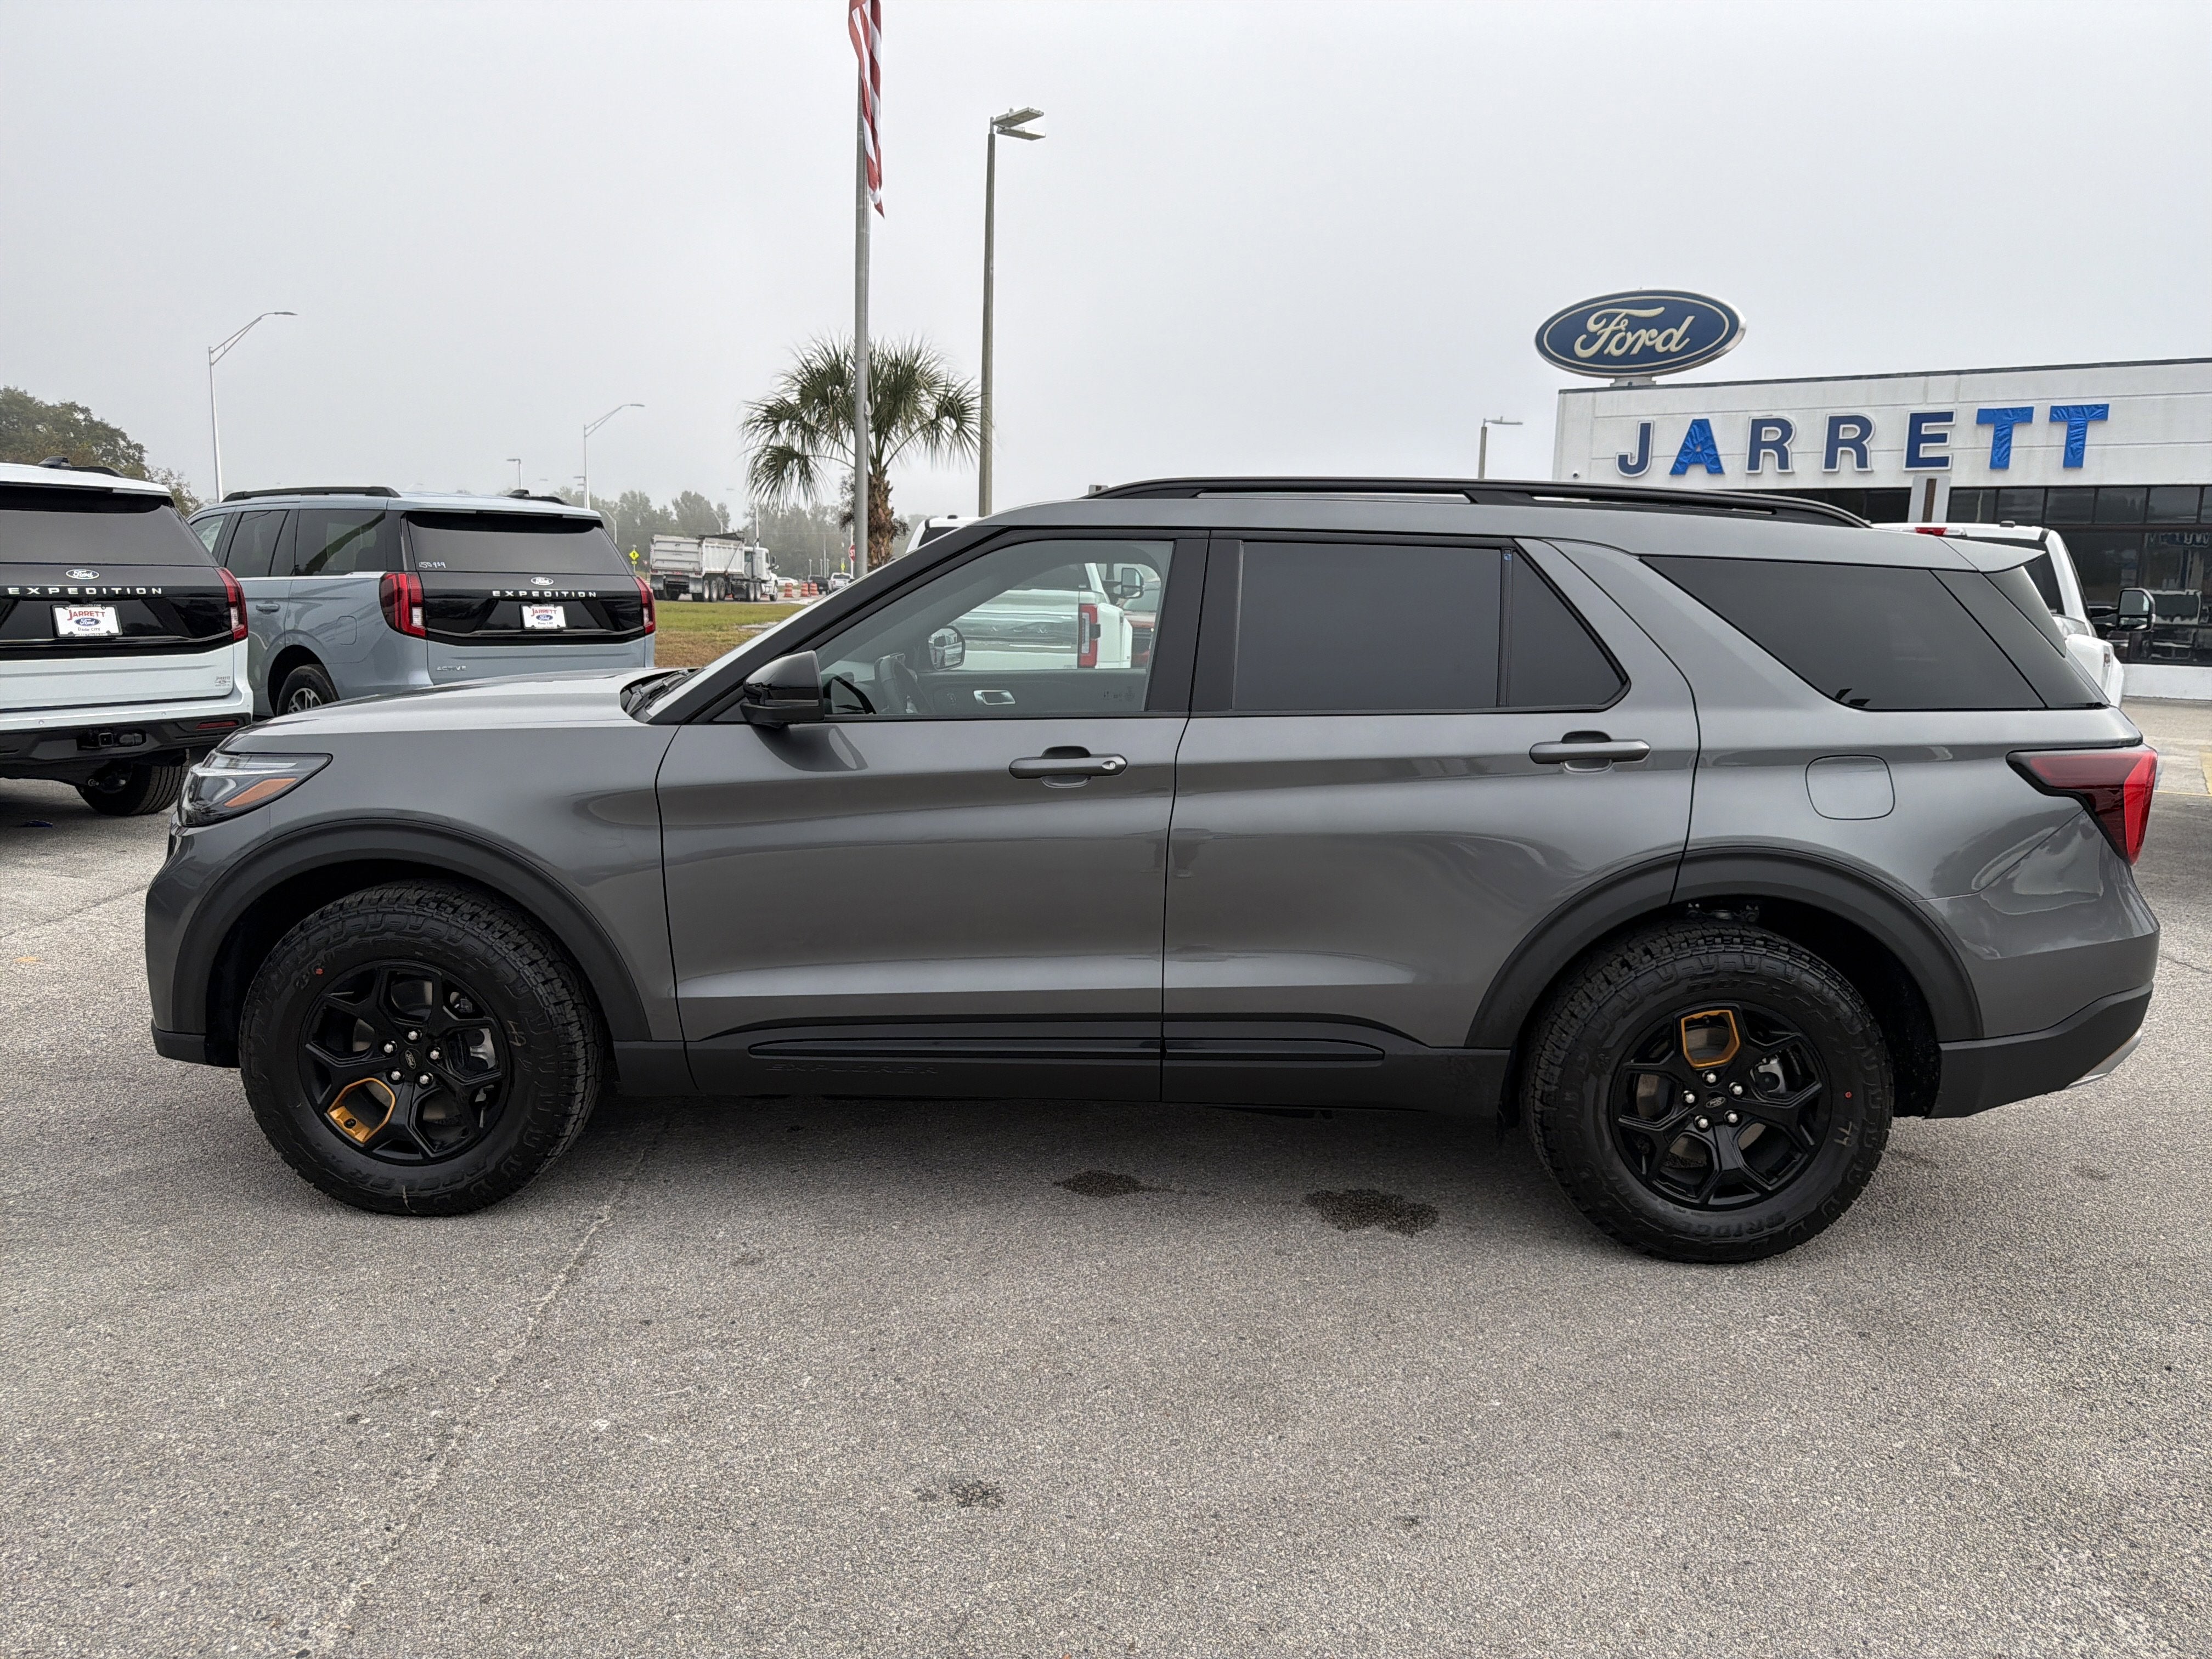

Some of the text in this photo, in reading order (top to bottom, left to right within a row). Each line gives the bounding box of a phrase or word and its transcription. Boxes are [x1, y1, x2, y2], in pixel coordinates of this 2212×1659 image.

[1573, 306, 1695, 358] Ford
[1615, 403, 2109, 477] JARRETT
[73, 569, 94, 578] Ford
[67, 610, 105, 620] JARRETT
[531, 608, 557, 617] JARRETT
